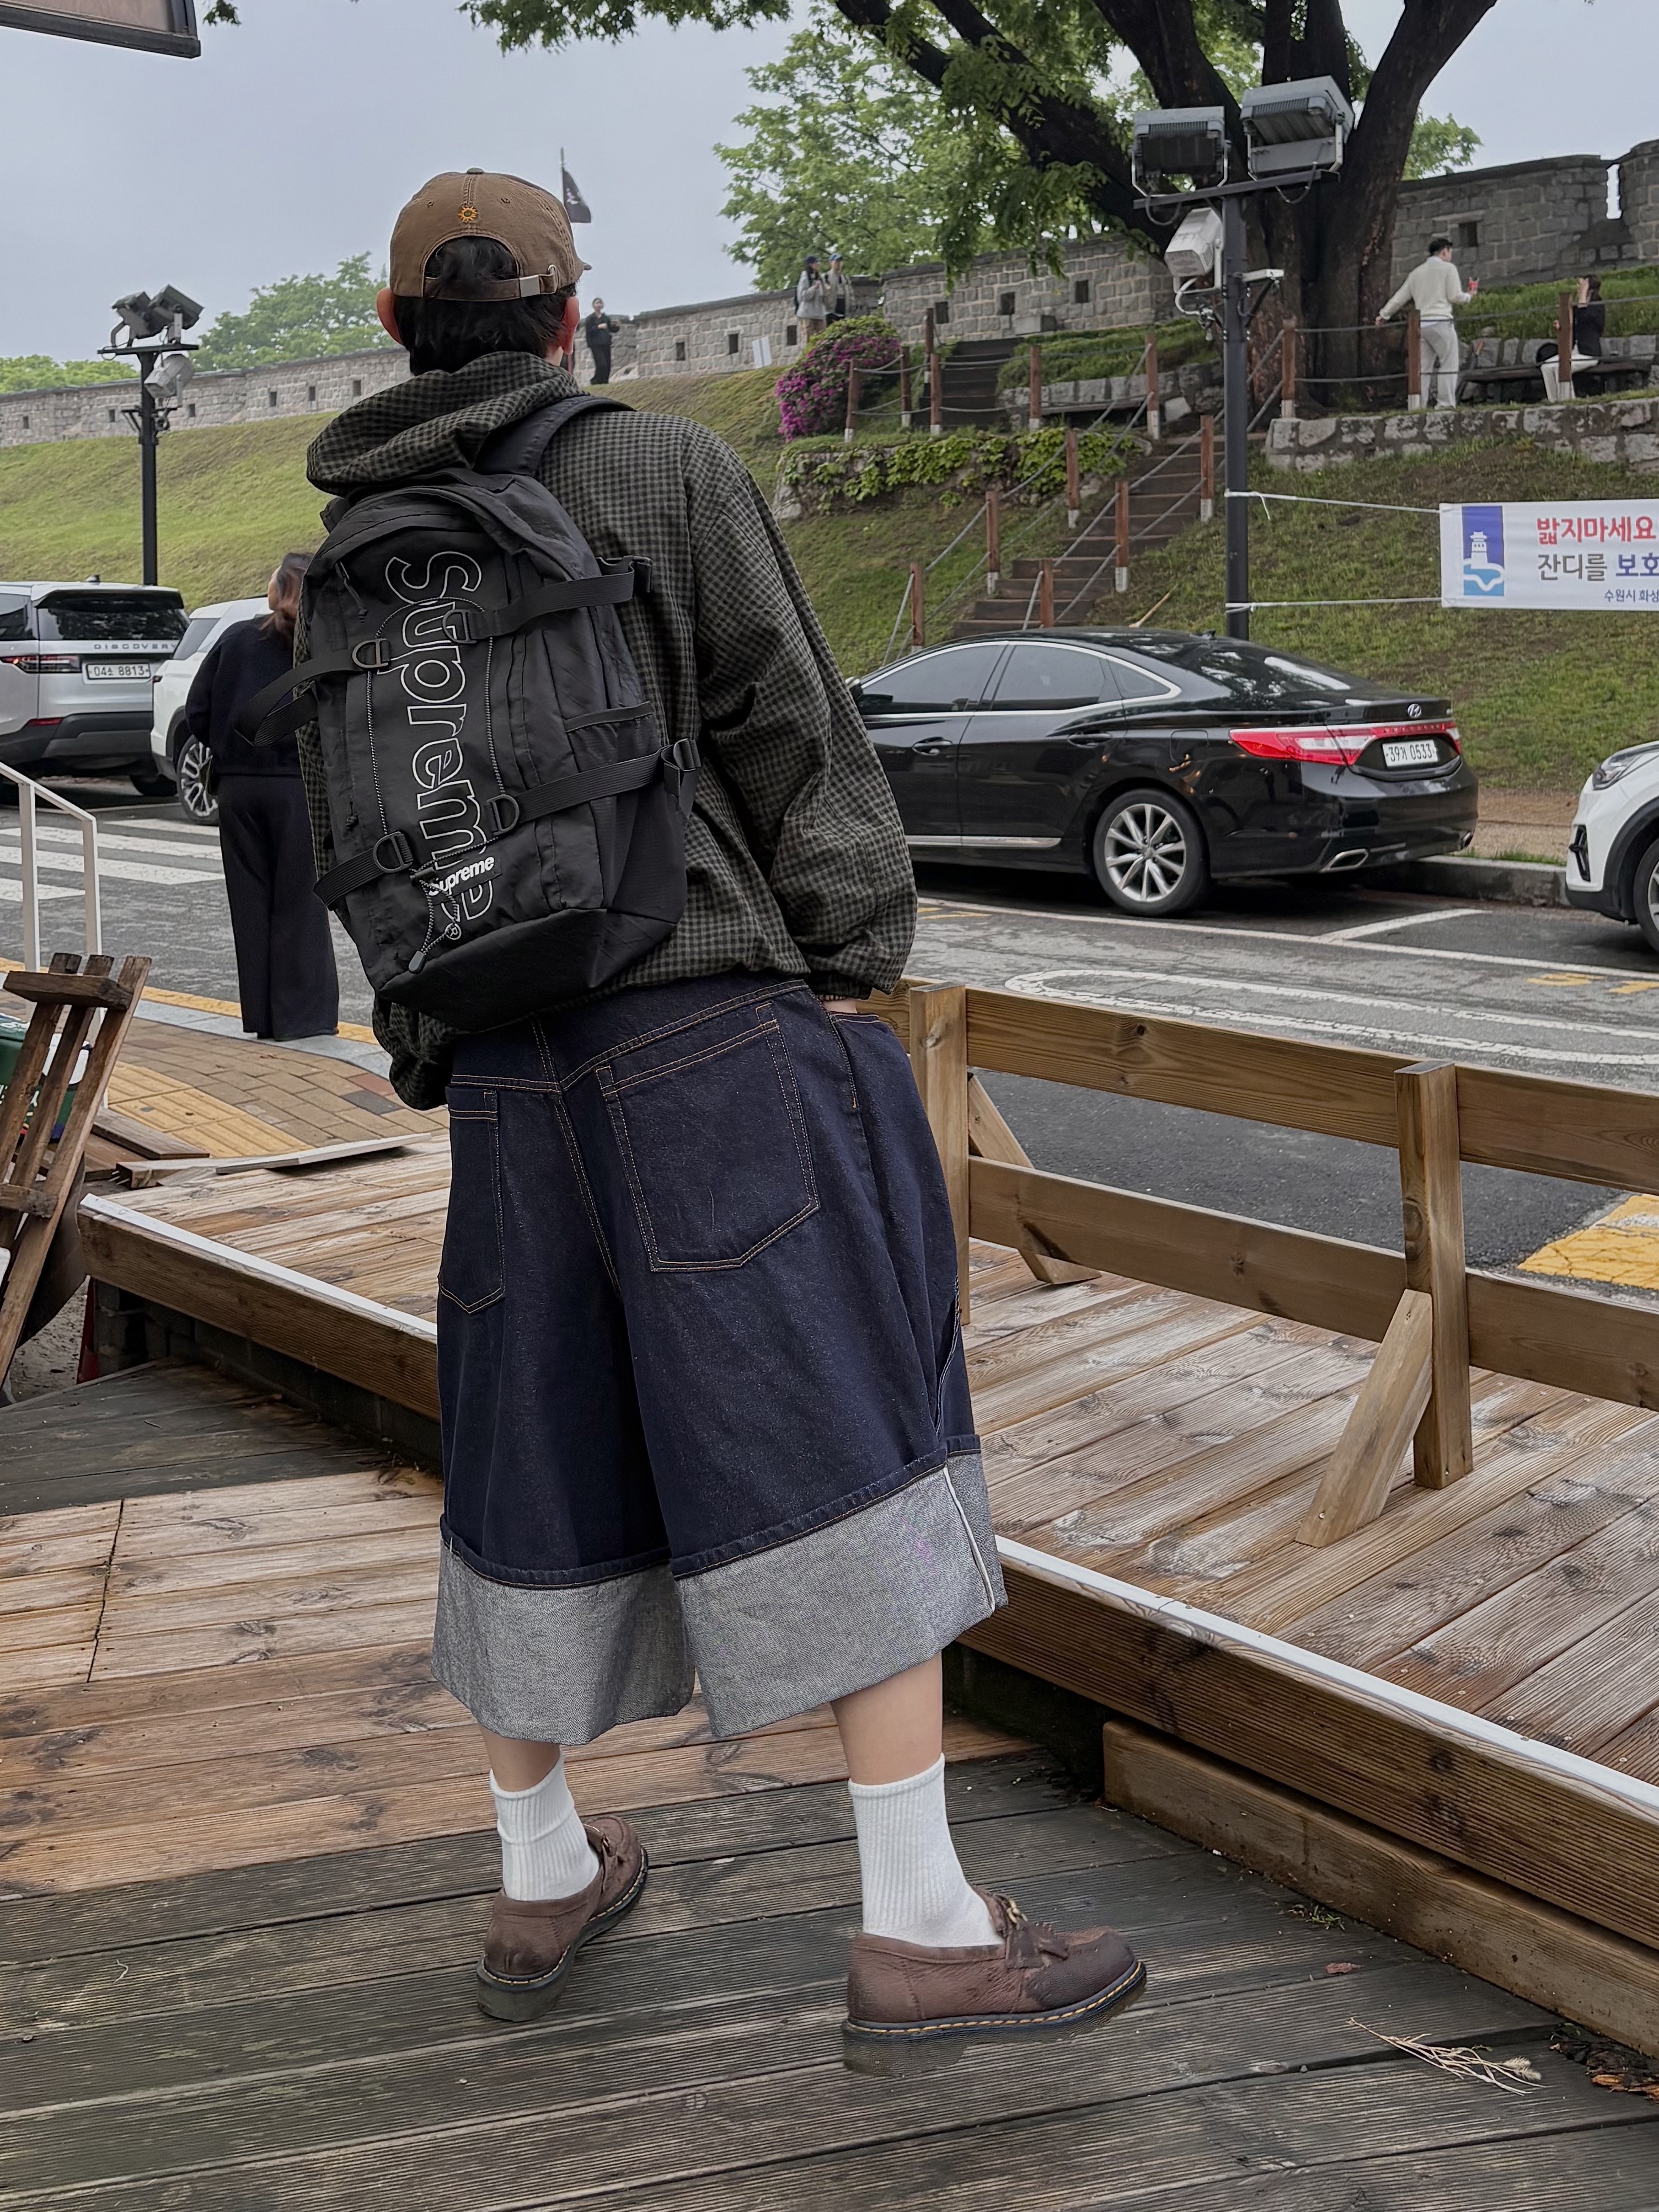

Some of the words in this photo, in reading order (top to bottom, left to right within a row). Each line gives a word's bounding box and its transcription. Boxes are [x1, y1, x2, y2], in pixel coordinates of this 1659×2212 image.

[1537, 516, 1656, 544] 밟지마세요
[1538, 553, 1608, 581] 잔디를
[1604, 589, 1636, 603] 수원시
[1409, 743, 1433, 760] 0533
